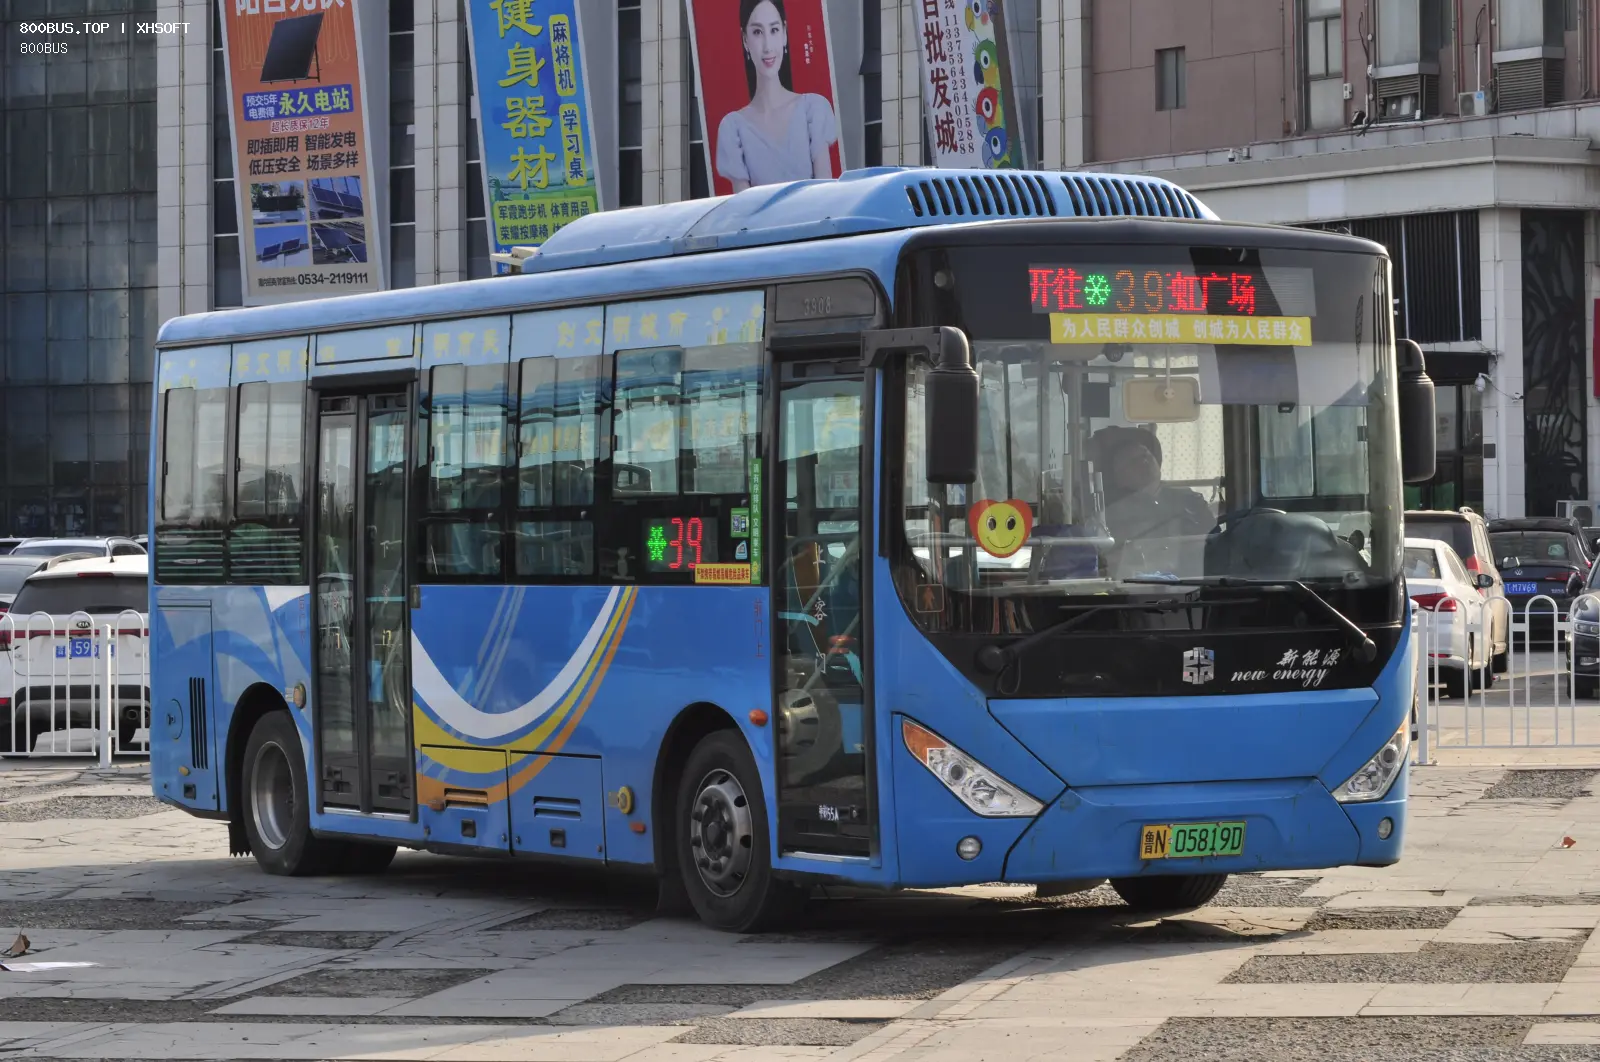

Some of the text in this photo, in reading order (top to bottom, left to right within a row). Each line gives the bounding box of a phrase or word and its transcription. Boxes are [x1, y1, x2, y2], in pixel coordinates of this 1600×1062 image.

[552, 21, 575, 91] 麻将机
[246, 93, 278, 108] 预交5年
[278, 87, 350, 116] 永久电站
[489, 0, 556, 190] 健身器材
[248, 106, 275, 119] 电费得
[270, 117, 330, 133] 超长质保12年
[247, 130, 356, 155] 即插即用 智能发电
[562, 108, 584, 179] 学习桌
[249, 150, 359, 176] 低压安全 场景多样
[498, 200, 590, 220] 军霞跑步机 体育用品
[297, 272, 369, 286] 0534-2119111
[1115, 269, 1164, 313] 39
[1062, 317, 1304, 342] 为人民群众创城 创城为人民群众
[668, 517, 703, 569] 39
[1276, 648, 1341, 667] 新能源
[1231, 668, 1328, 688] new energy
[1144, 827, 1243, 855] 鲁N 05819D
